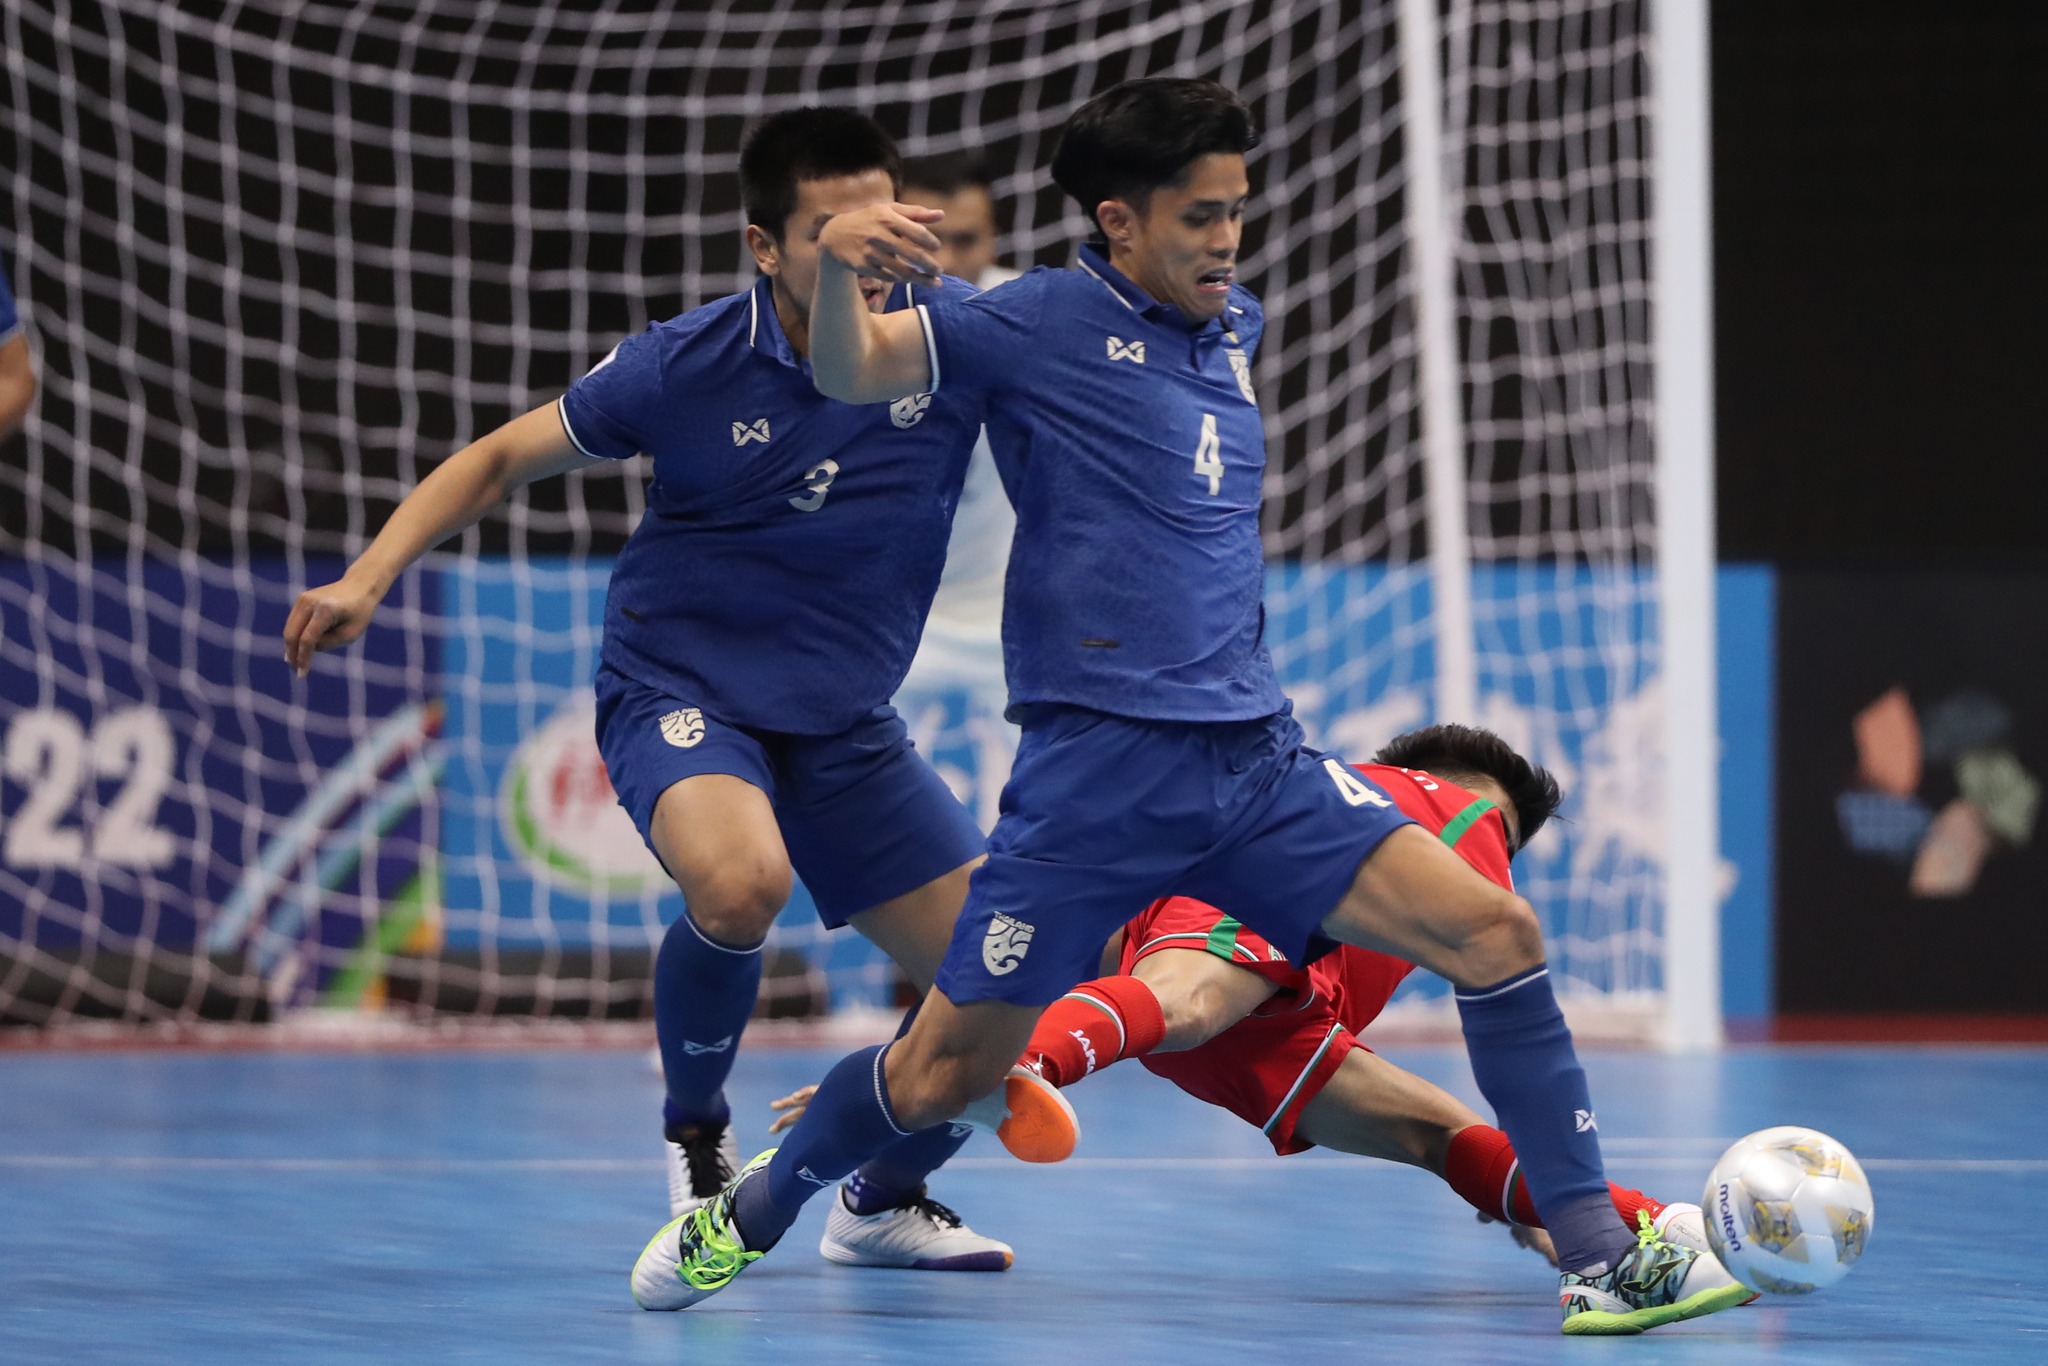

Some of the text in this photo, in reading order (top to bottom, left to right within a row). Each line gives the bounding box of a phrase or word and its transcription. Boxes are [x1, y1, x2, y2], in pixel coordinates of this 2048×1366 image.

[788, 458, 840, 512] 3
[1194, 413, 1225, 496] 4
[4, 705, 176, 872] 22
[1323, 758, 1393, 808] 4
[1719, 1183, 1742, 1252] molten
